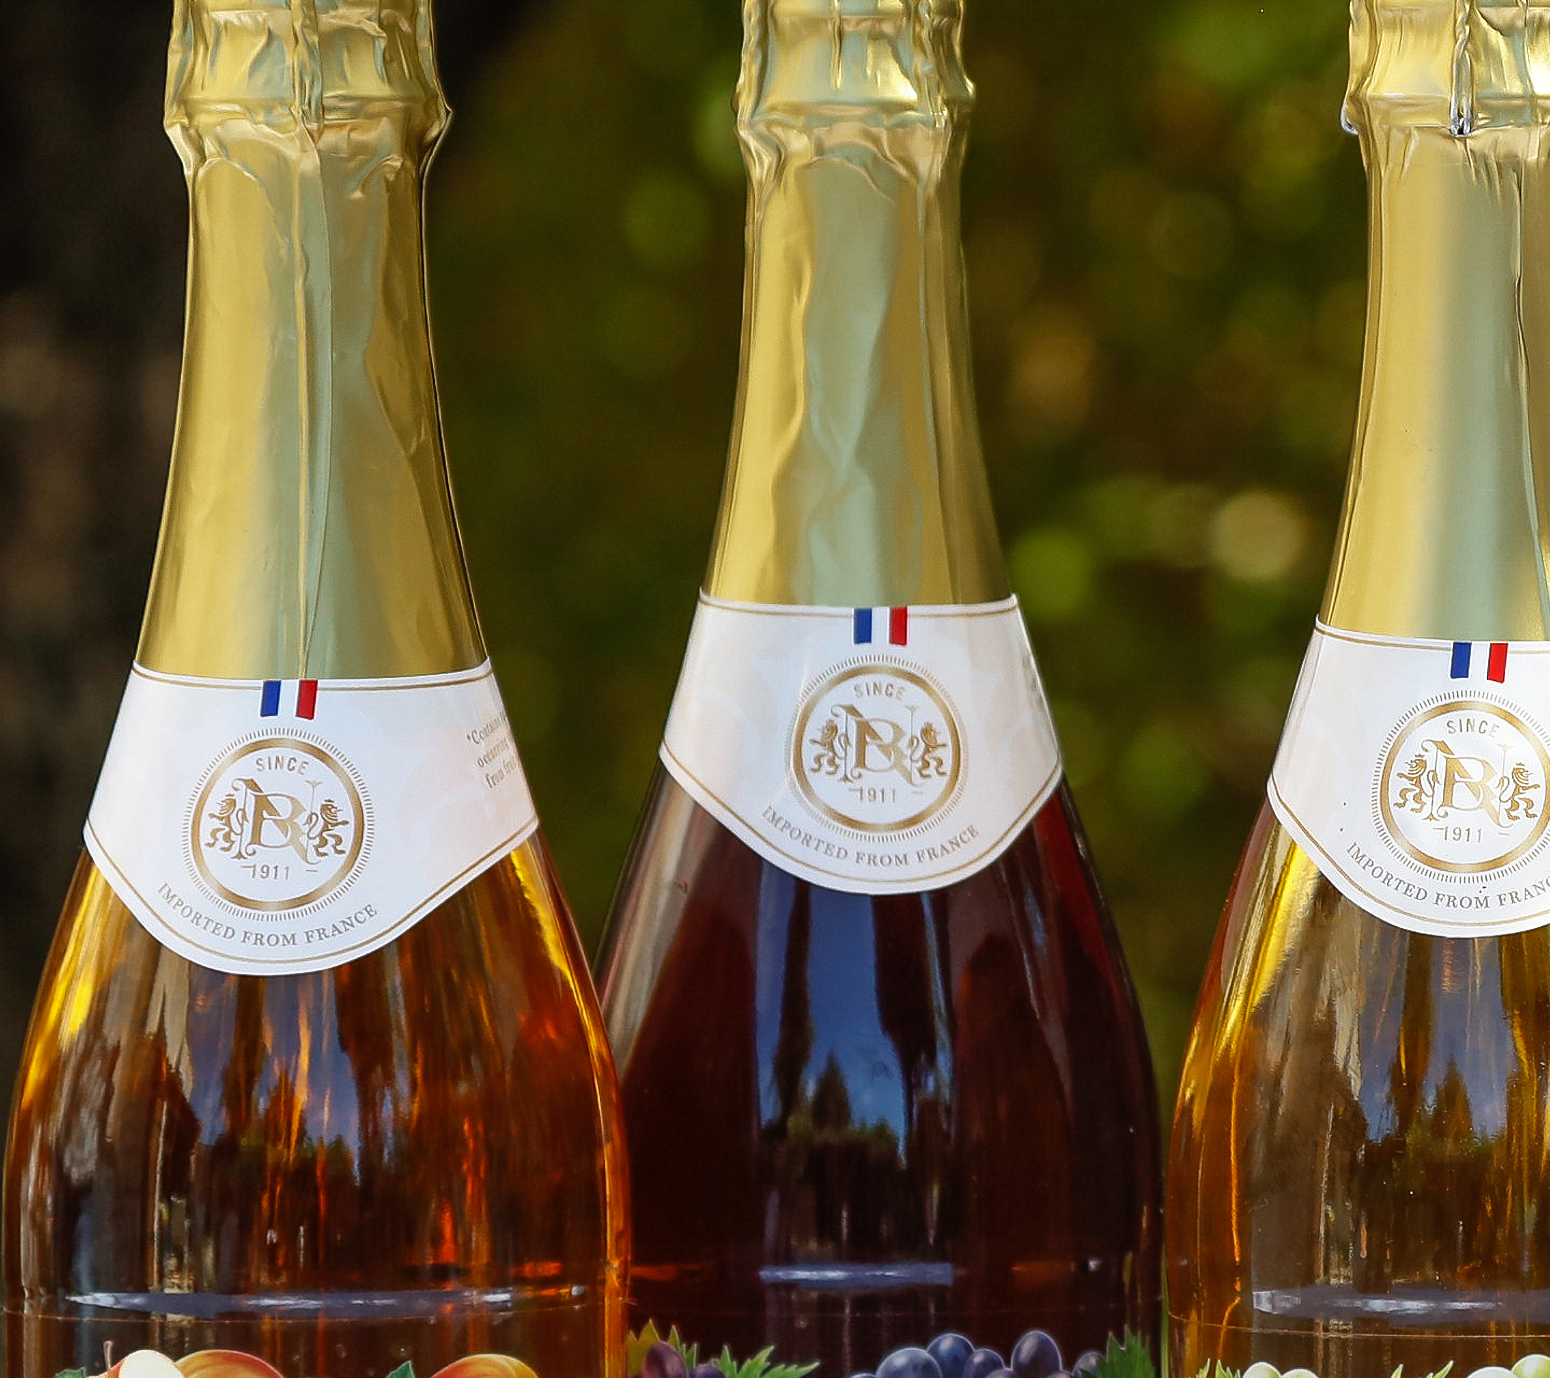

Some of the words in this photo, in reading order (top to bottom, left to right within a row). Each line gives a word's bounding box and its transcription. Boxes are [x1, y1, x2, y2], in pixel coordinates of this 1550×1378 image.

[852, 680, 906, 701] SINCE
[1446, 718, 1501, 739] SINCE
[254, 754, 310, 777] SINCE
[857, 785, 897, 804] 1911
[762, 804, 850, 862] IMPORTED
[854, 850, 910, 868] FROM
[915, 823, 981, 865] FRANCE
[1442, 826, 1483, 844] 1911
[250, 863, 291, 882] 1911
[1345, 841, 1429, 902] IMPORTED
[1432, 892, 1491, 911] FROM
[156, 881, 237, 942] IMPORTED
[240, 929, 298, 948] FROM
[303, 903, 379, 945] FRANCE
